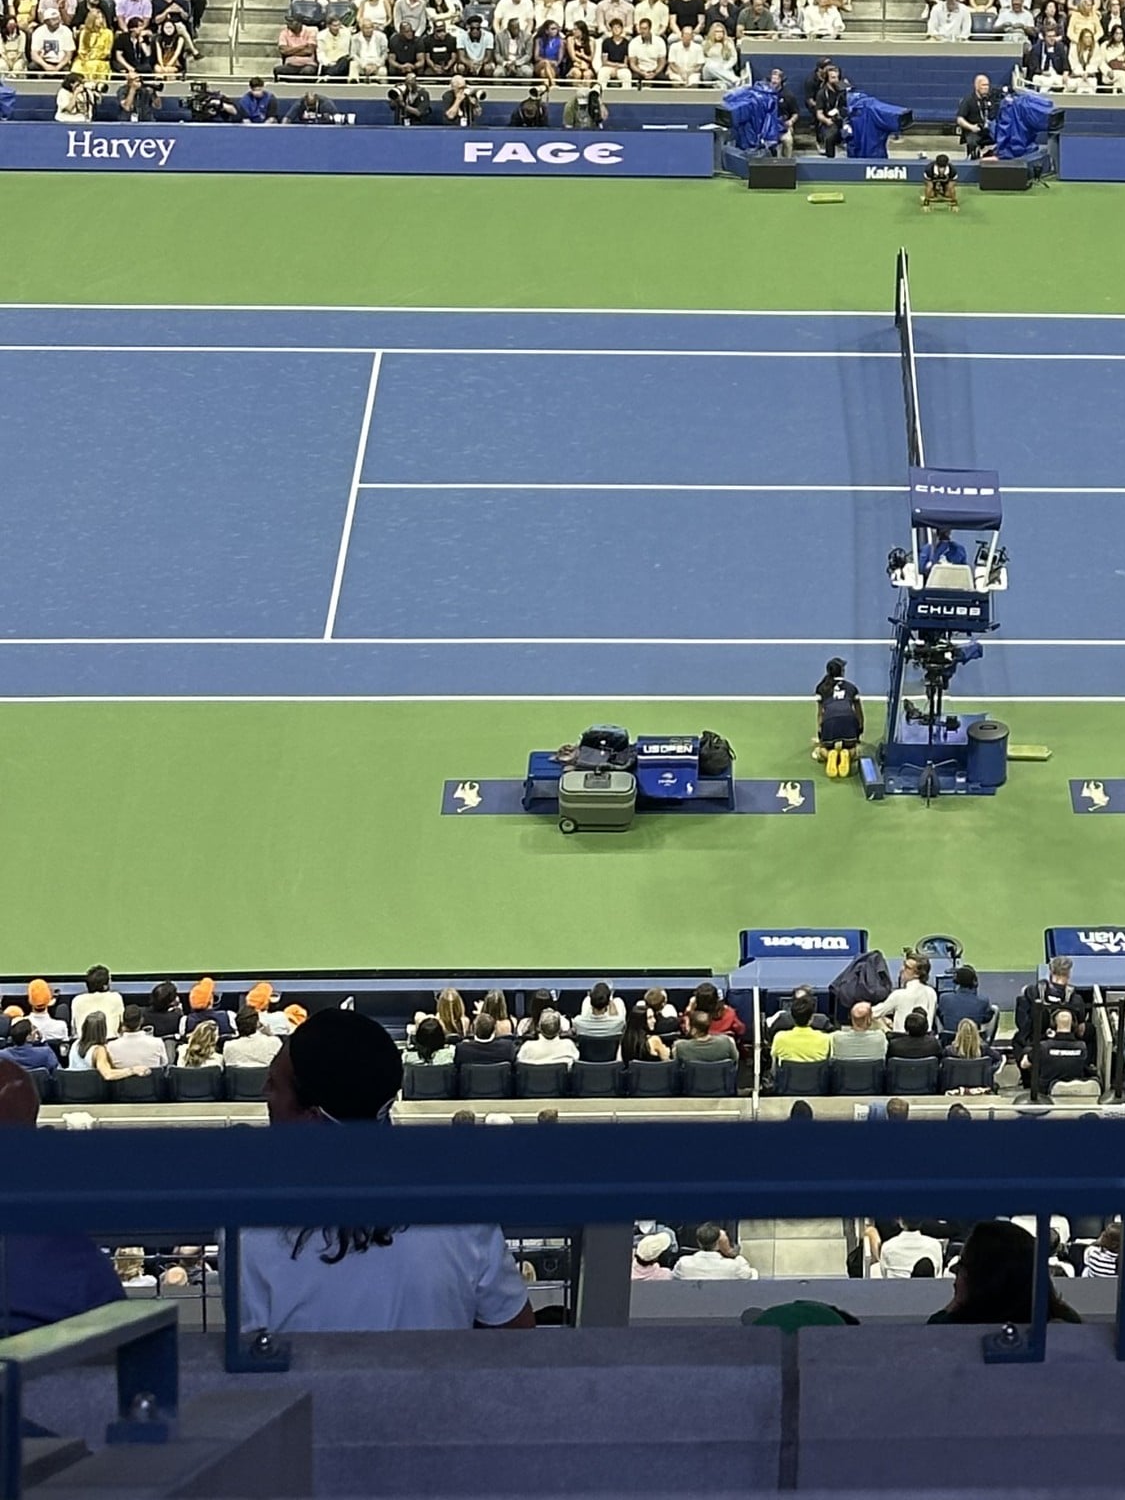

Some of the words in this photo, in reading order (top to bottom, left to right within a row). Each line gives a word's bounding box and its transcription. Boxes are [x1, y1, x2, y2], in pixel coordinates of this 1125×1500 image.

[66, 130, 176, 166] Harvey
[464, 141, 624, 165] FAGE
[917, 604, 981, 616] CHUBB
[760, 936, 850, 950] Wilson
